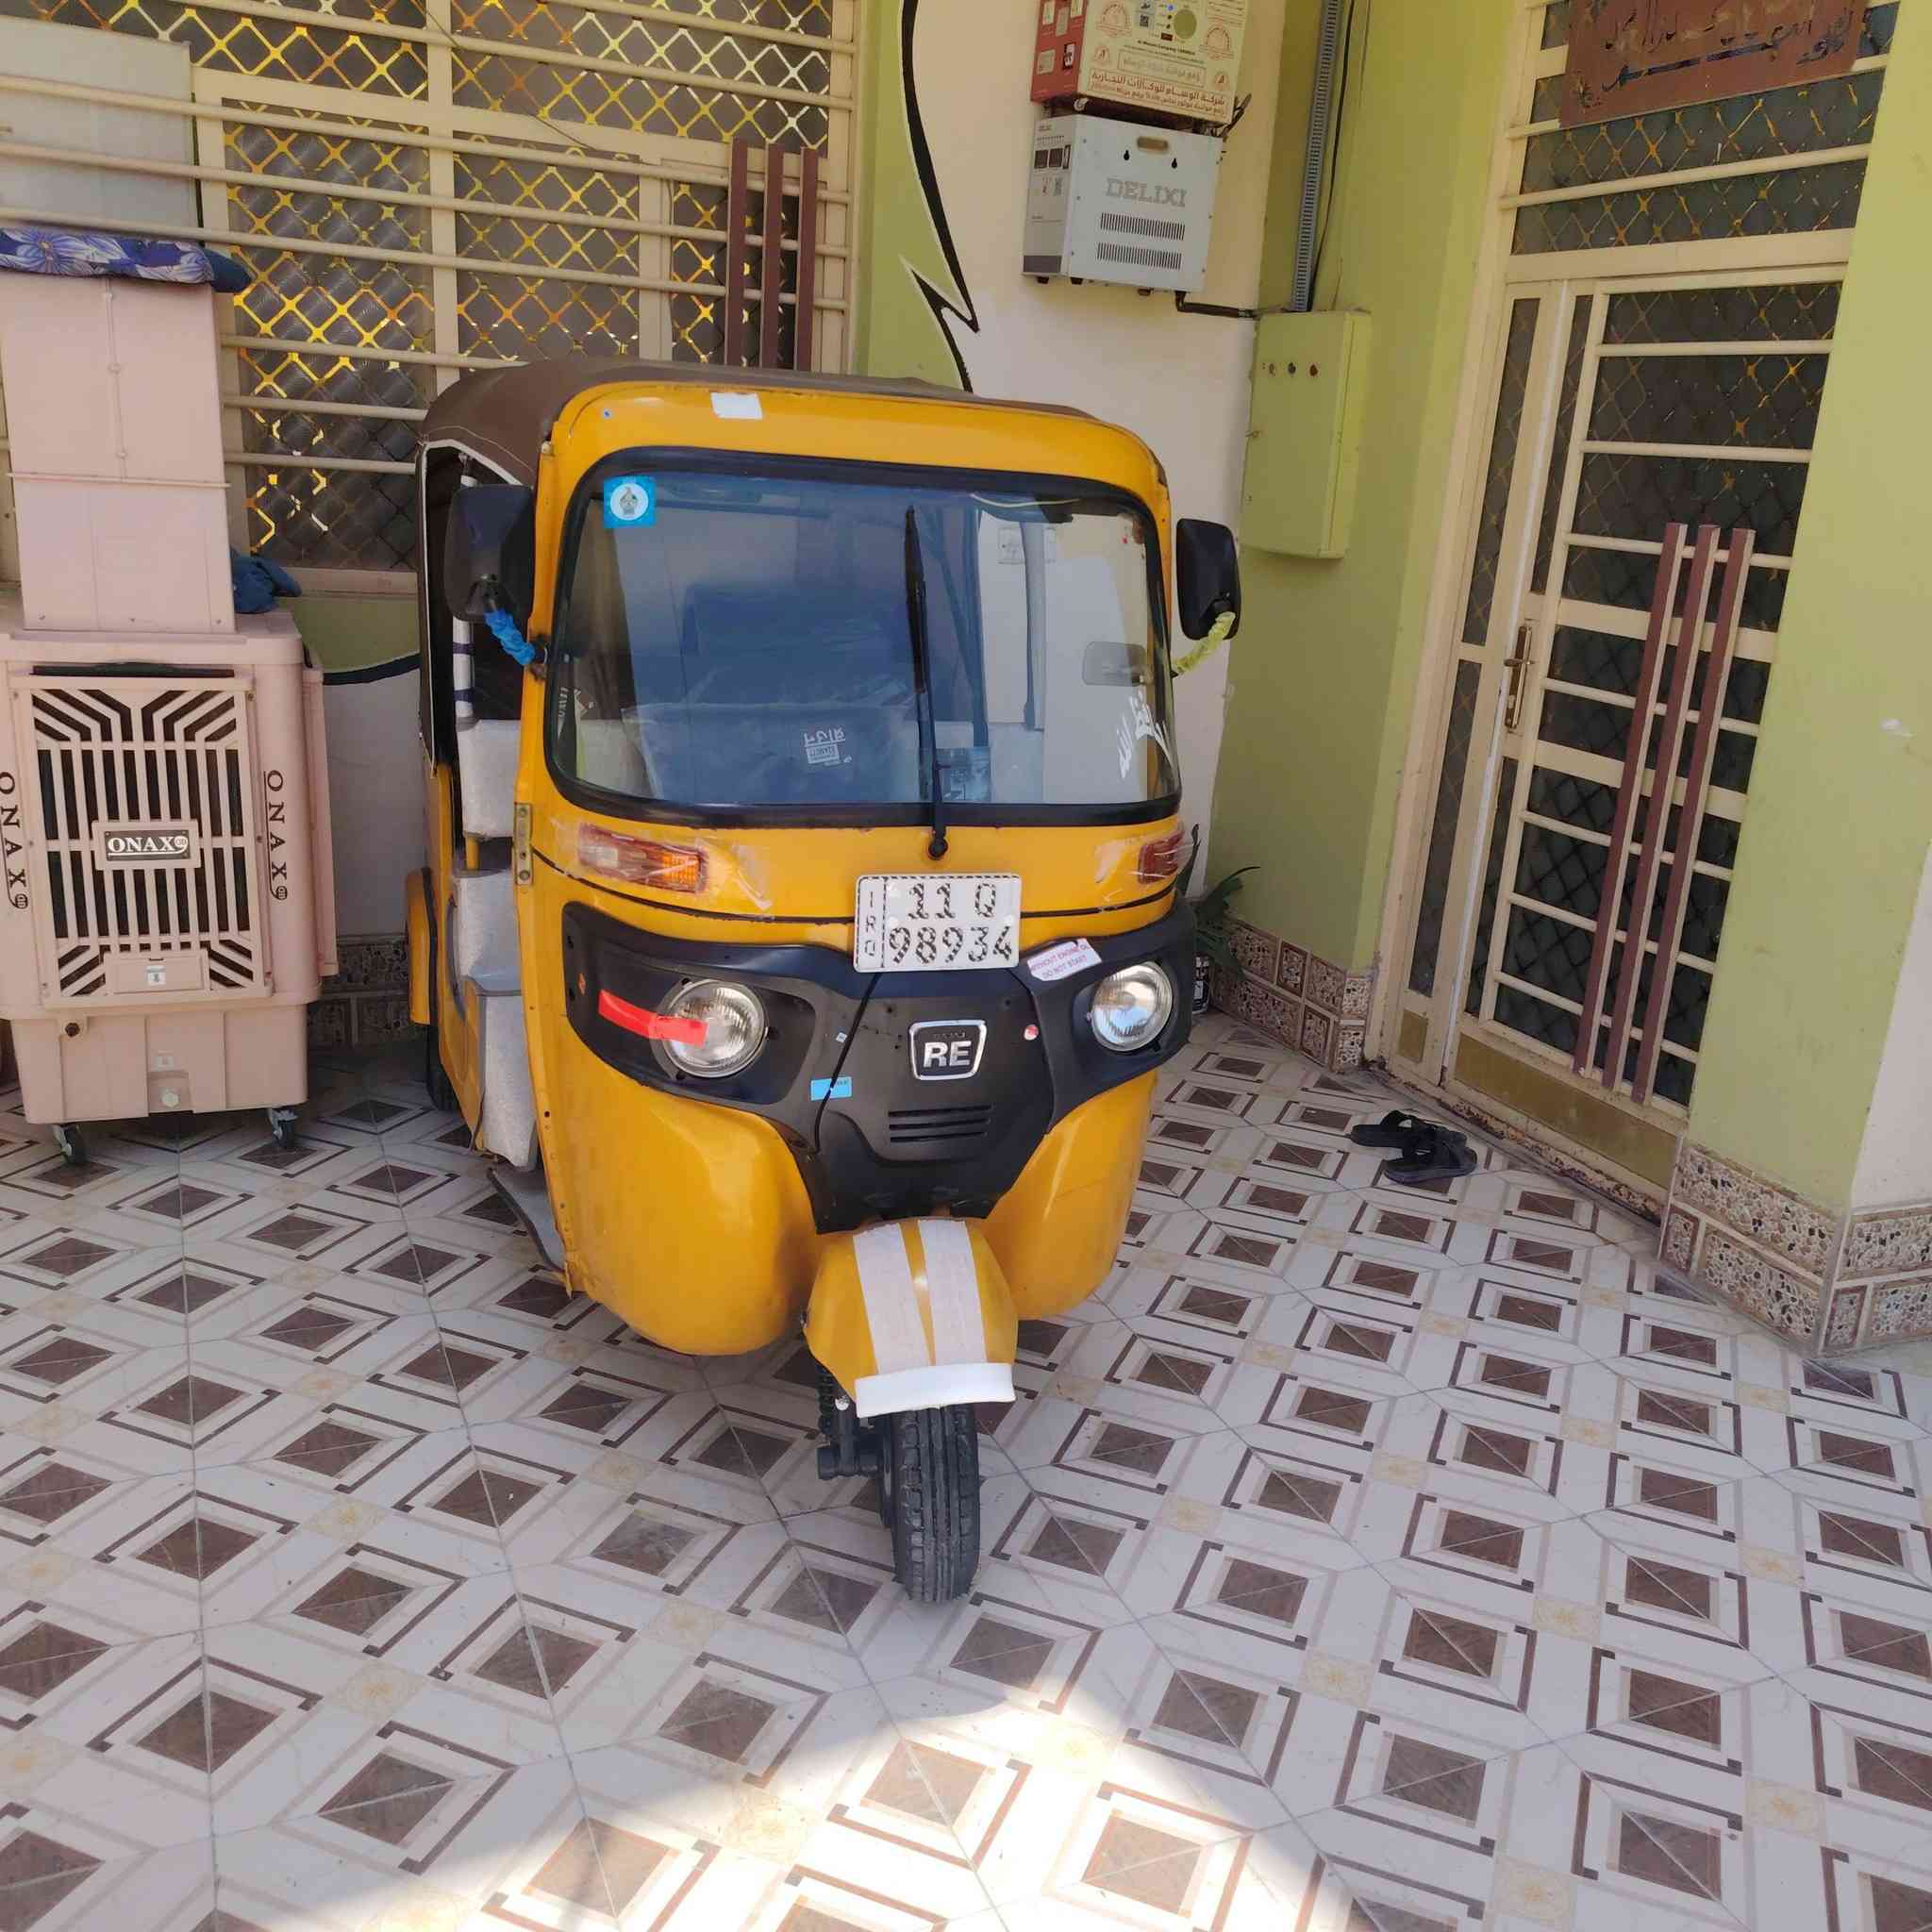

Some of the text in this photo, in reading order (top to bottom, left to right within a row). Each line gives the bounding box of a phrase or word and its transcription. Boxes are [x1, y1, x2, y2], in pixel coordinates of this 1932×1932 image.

[1106, 177, 1187, 208] DELIXI
[267, 770, 288, 881] ONAX
[108, 836, 175, 853] ONAX
[908, 883, 956, 920] 11
[889, 924, 1012, 964] 98934
[923, 1041, 972, 1068] RE
